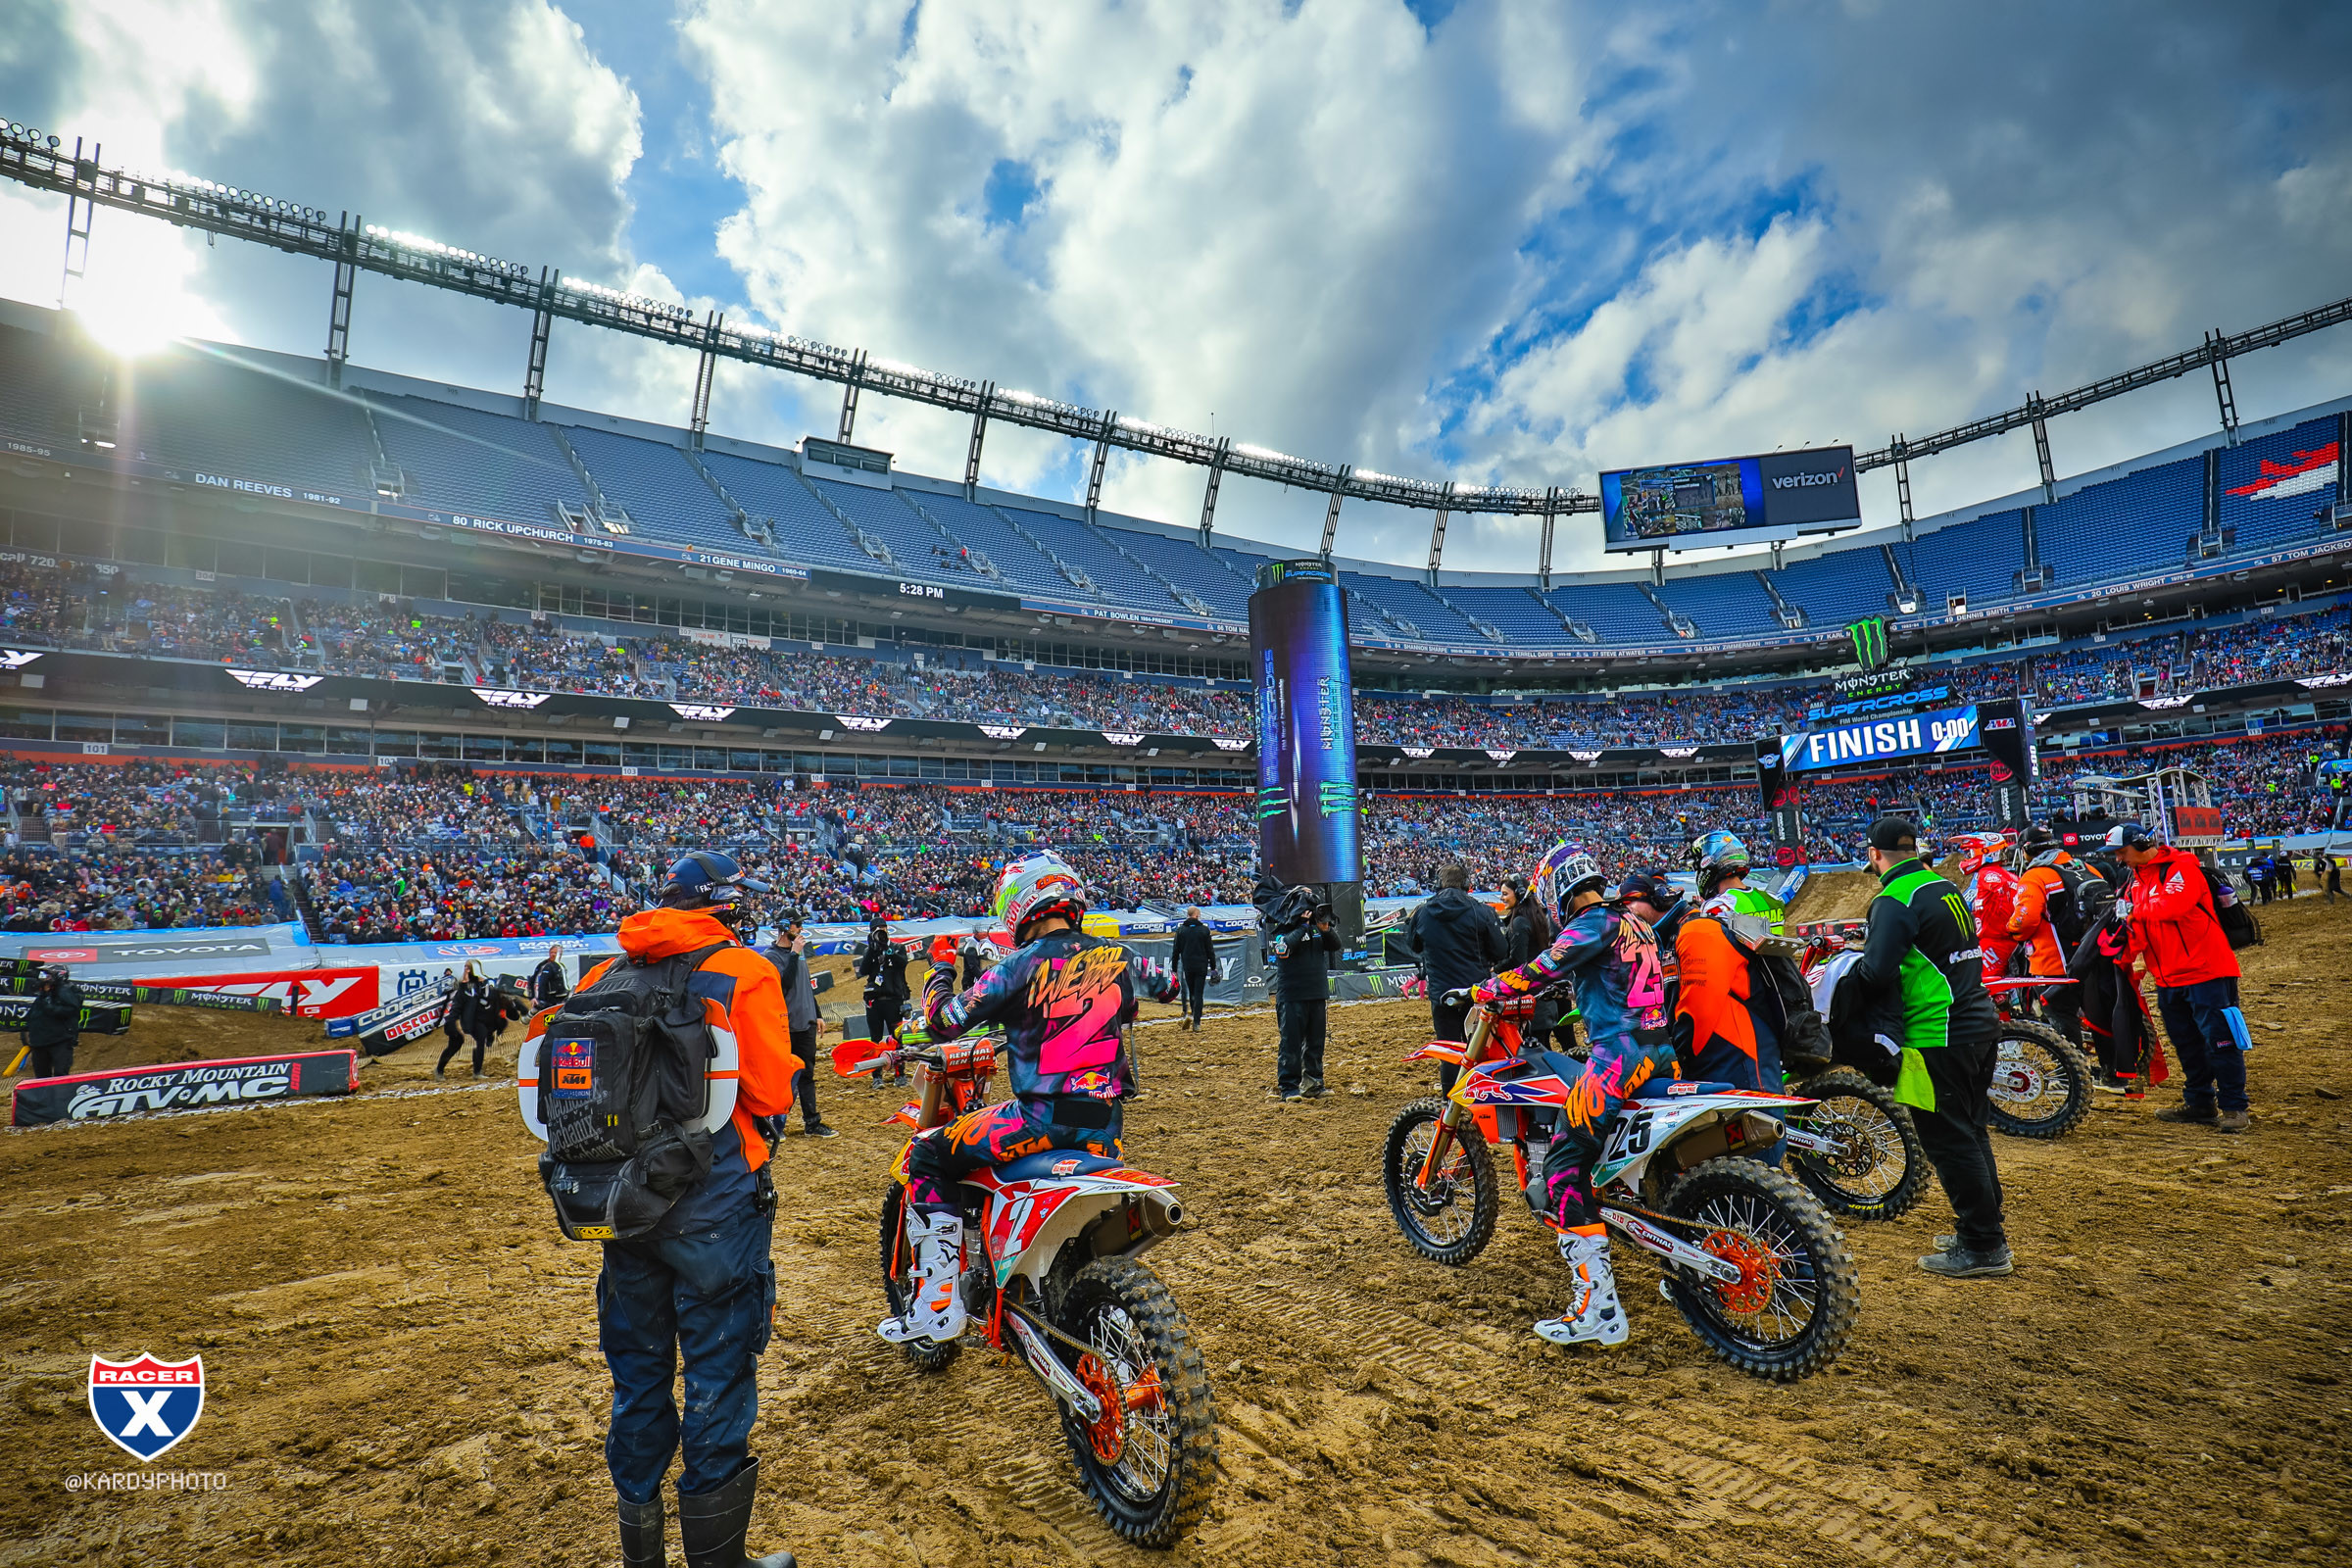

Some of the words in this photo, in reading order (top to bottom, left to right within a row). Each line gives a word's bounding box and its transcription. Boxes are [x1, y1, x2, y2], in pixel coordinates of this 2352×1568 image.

[7, 441, 51, 458] 1985-95
[1772, 470, 1838, 489] verizon
[195, 472, 229, 488] DAN
[232, 479, 293, 498] REEVES
[302, 491, 341, 506] 1981-92
[452, 514, 468, 526] 80
[472, 518, 505, 533] RICK
[506, 522, 575, 544] UPCHURCH
[583, 536, 614, 549] 1975-83
[0, 552, 25, 564] call
[2271, 554, 2283, 564] 57
[2286, 549, 2309, 561] TOM
[2311, 539, 2352, 556] JACKSO
[699, 553, 711, 564] 21
[711, 556, 741, 568] GENE
[742, 560, 776, 573] MINGO
[899, 582, 924, 596] 5:28
[925, 586, 944, 599] PM
[2105, 585, 2131, 595] LOUIS
[2132, 577, 2167, 590] WRIGHT
[1094, 609, 1108, 619] PAT
[1109, 611, 1140, 622] BOWLEN
[1956, 611, 1985, 621] DENNIS
[1985, 607, 2010, 617] SMITH
[1403, 643, 1429, 653] SHANNON
[1722, 641, 1762, 651] ZIMMERMAN
[231, 669, 324, 689] FLY
[1835, 668, 1911, 692] MONSTER
[476, 689, 551, 706] FLY
[1847, 683, 1901, 698] ENERGY
[1807, 686, 1949, 721] SUPERCROSS
[2142, 694, 2195, 708] FLY
[673, 704, 736, 718] FLY
[1317, 676, 1333, 750] MONSTER
[1851, 714, 1870, 723] World
[1870, 707, 1914, 722] Championship
[840, 715, 893, 728] FLY
[1985, 718, 2016, 730] AMA
[982, 725, 1028, 737] FLY
[1105, 732, 1146, 744] FLY
[1809, 718, 1922, 762] FINISH
[1931, 716, 1970, 742] 0:00
[86, 744, 107, 754] 101
[1215, 738, 1251, 749] FLY
[1405, 748, 1436, 757] FLY
[1665, 748, 1699, 757] FLY
[1748, 907, 1785, 923] OMAC
[113, 943, 263, 956] TOYOTA
[1132, 956, 1236, 981] OAKY
[77, 982, 132, 996] ONSTER
[191, 992, 253, 1005] MONSTER
[358, 988, 439, 1027] COOPER
[1038, 983, 1123, 1075] 2
[949, 1054, 992, 1066] RENHAL
[105, 1074, 179, 1095] ROCKY
[178, 1061, 292, 1087] MOUNTAIN
[562, 1073, 586, 1085] KTM
[1622, 1055, 1655, 1100] KTM
[1607, 1111, 1655, 1162] 25
[1786, 1134, 1814, 1146] ENTHAL
[1000, 1134, 1054, 1162] KTM
[1612, 1212, 1625, 1224] DID
[1004, 1198, 1035, 1258] 2
